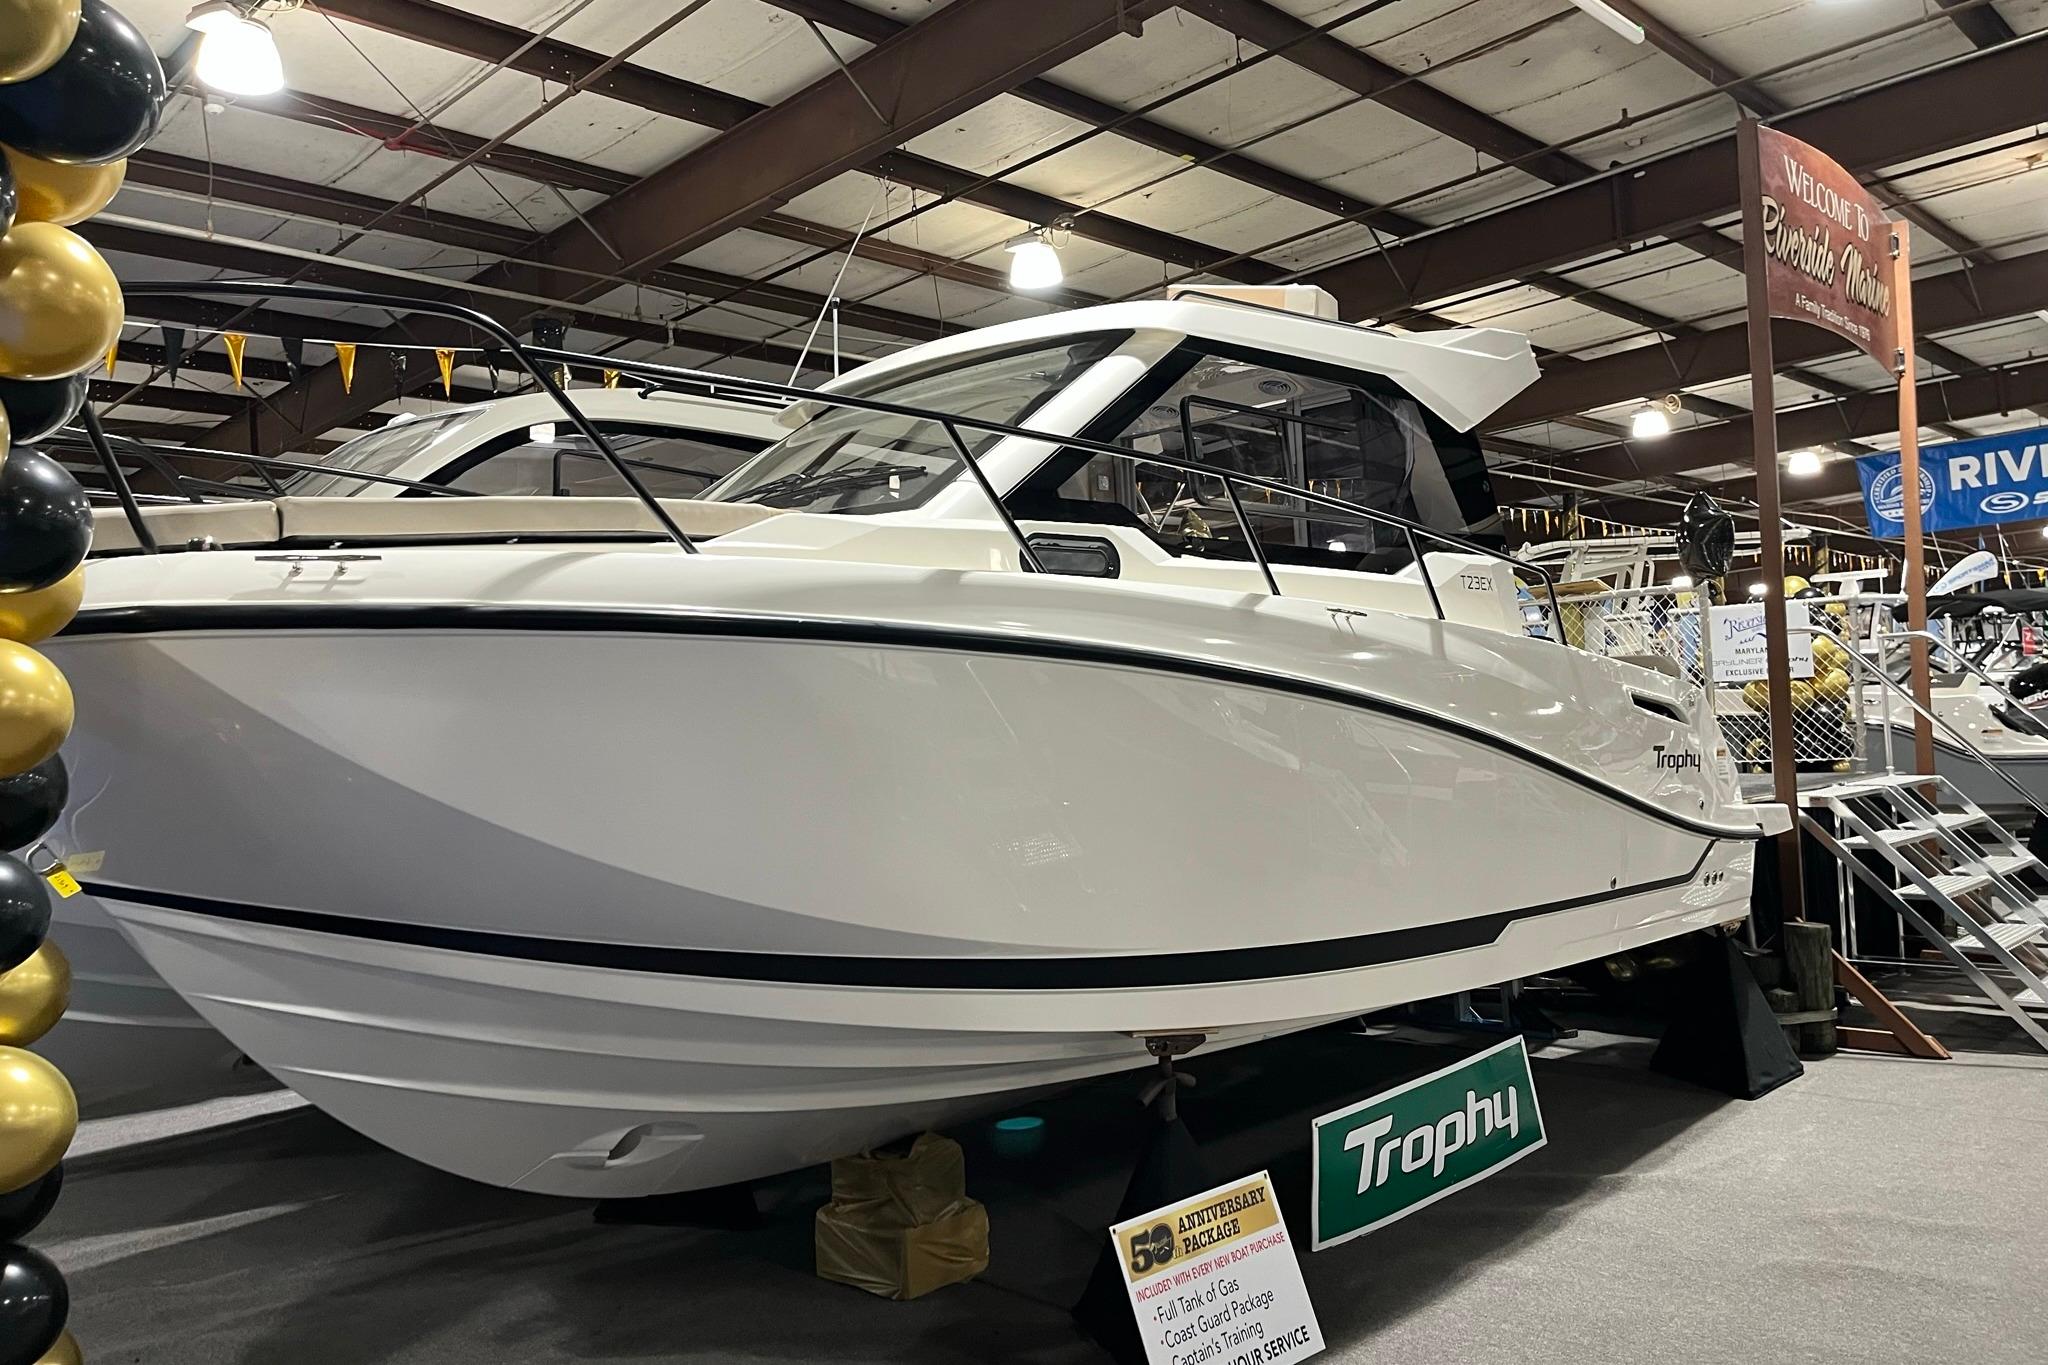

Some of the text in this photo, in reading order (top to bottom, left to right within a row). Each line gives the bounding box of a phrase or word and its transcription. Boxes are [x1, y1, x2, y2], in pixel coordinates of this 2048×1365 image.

[1783, 154, 1853, 231] WELCOME
[1761, 195, 1890, 318] Riverside Marine
[1794, 292, 1801, 308] A
[1801, 294, 1821, 320] Family
[1821, 304, 1845, 328] Tradition
[1844, 316, 1859, 336] Since
[1460, 575, 1493, 591] T23EX
[1725, 668, 1764, 677] EXCLUSIVE
[1653, 745, 1700, 774] Trophy
[1343, 1085, 1519, 1195] Trophy
[1178, 1186, 1266, 1234] ANNIVERSARY
[1182, 1218, 1241, 1255] PACKAGE
[1136, 1231, 1286, 1304] INCLUDED WITH EVERY NEW BOAT PURCHASE
[1156, 1278, 1240, 1325] Full Tank of Gas
[1164, 1289, 1274, 1348] Coast Guard Package
[1221, 1321, 1265, 1350] Training
[1263, 1325, 1311, 1361] SERVICE
